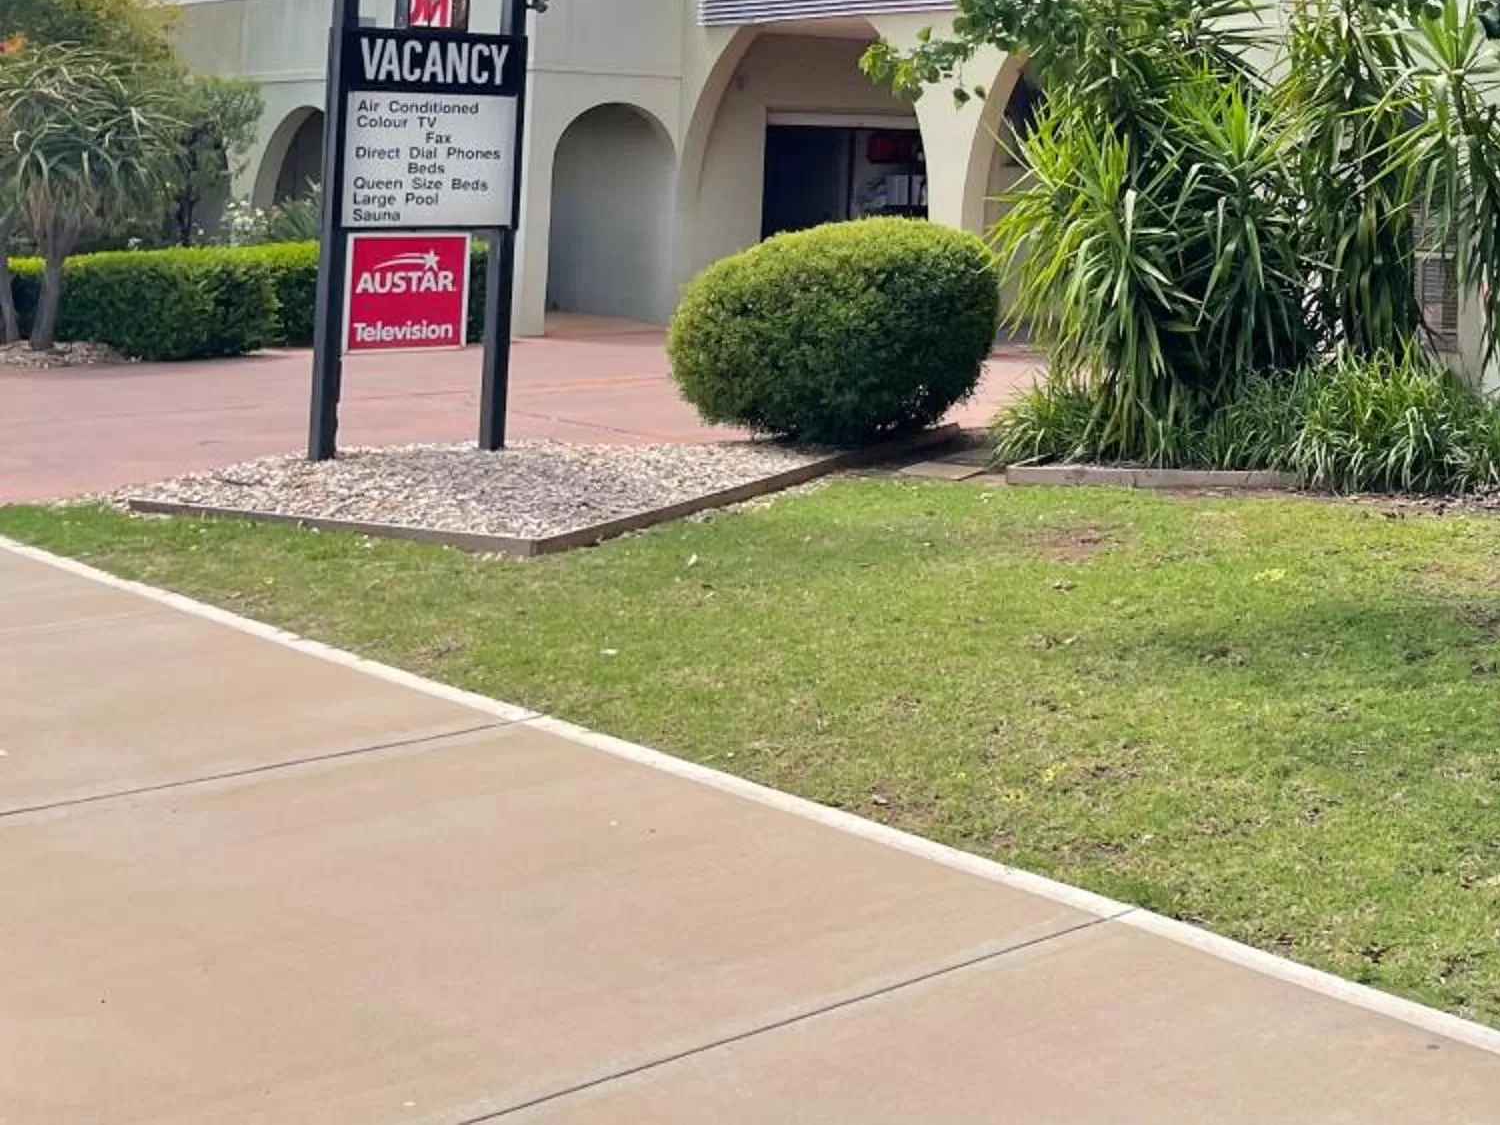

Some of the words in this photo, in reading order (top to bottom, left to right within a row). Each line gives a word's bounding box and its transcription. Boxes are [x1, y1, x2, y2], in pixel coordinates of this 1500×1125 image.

[360, 37, 510, 86] VACANCY
[357, 100, 380, 112] Air
[389, 100, 479, 114] Conditioned
[357, 115, 408, 128] Colour
[417, 116, 437, 128] TV
[426, 132, 452, 144] Fax
[355, 147, 400, 160] Direct
[409, 147, 437, 160] Dial
[447, 148, 501, 161] Phones
[407, 162, 445, 174] Beds
[353, 176, 403, 190] Queen
[412, 177, 443, 190] Size
[451, 178, 488, 191] Beds
[353, 192, 396, 208] Large
[405, 192, 439, 205] Pool
[352, 208, 401, 222] Sauna
[355, 270, 454, 294] AUSTAR
[353, 320, 453, 342] Television
